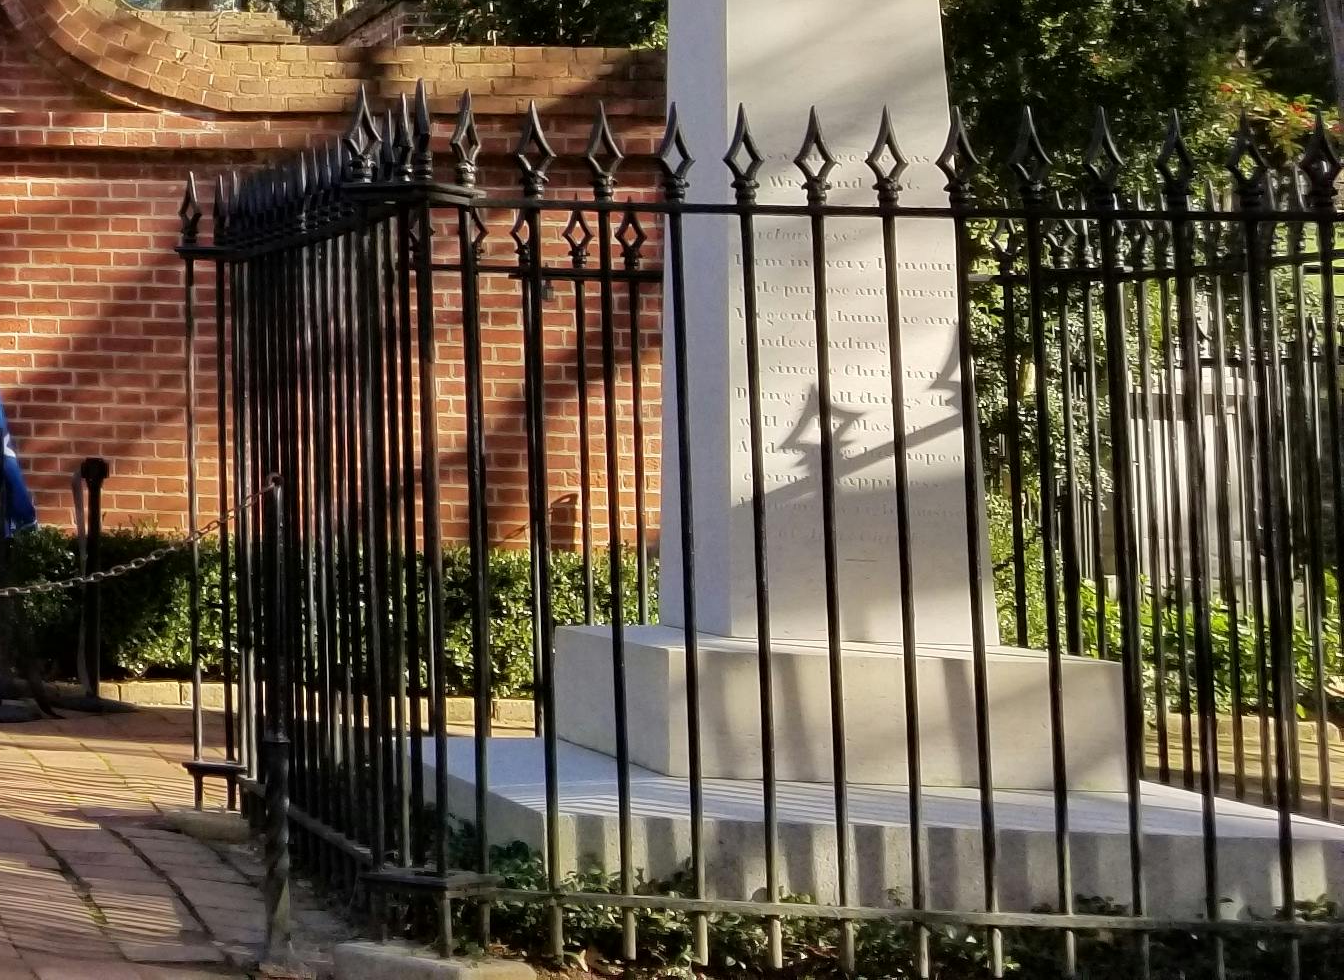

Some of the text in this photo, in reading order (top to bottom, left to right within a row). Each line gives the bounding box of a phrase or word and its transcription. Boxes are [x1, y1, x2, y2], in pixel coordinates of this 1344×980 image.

[783, 286, 848, 298] purose
[896, 287, 955, 299] ursui
[836, 310, 918, 325] humne
[740, 335, 887, 355] cndescnding
[769, 360, 942, 380] sincee Chrisian
[736, 386, 792, 406] Ding
[860, 391, 921, 410] thigs
[740, 415, 778, 428] wll
[737, 440, 776, 454] Ad
